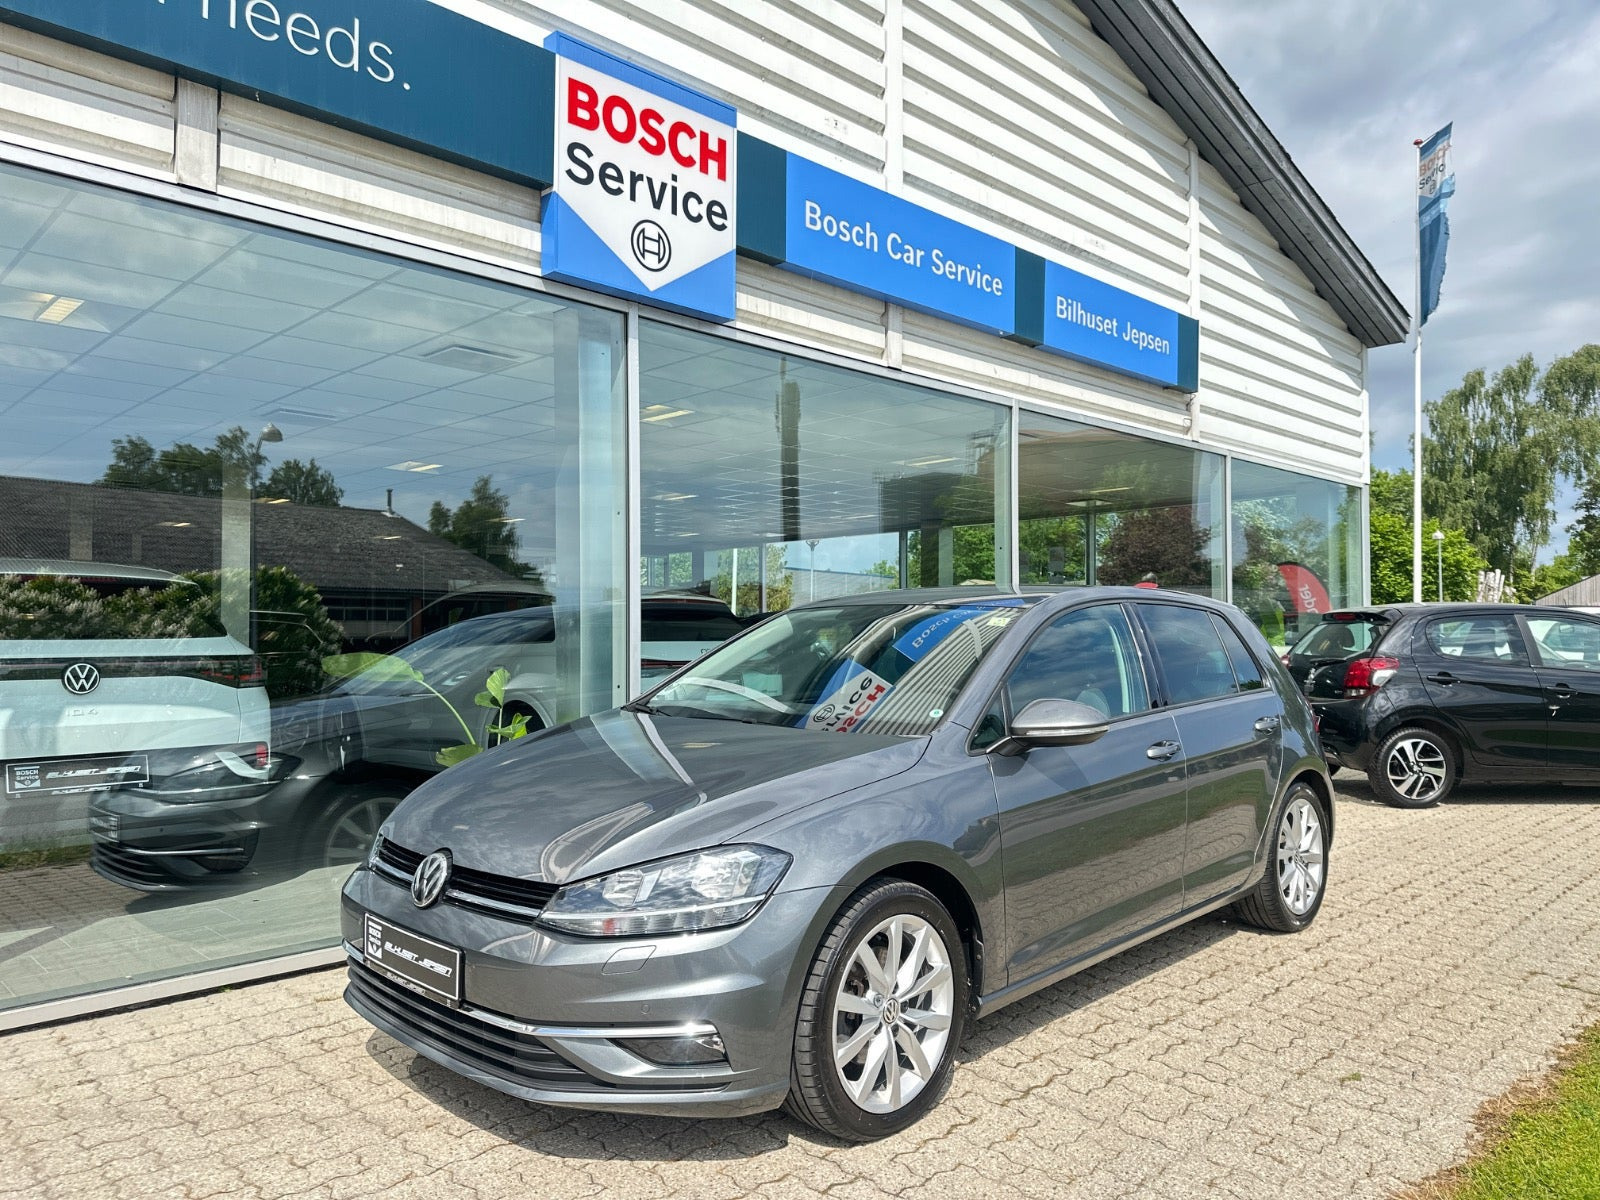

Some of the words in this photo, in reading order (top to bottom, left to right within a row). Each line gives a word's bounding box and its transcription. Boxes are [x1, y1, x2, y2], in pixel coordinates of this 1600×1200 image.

[567, 77, 727, 182] BOSCH
[565, 142, 728, 232] Service
[805, 200, 879, 253] Bosch
[886, 232, 925, 268] Car
[931, 248, 1004, 296] Service
[1056, 295, 1118, 337] Bilhuset
[1122, 321, 1170, 355] Jepsen
